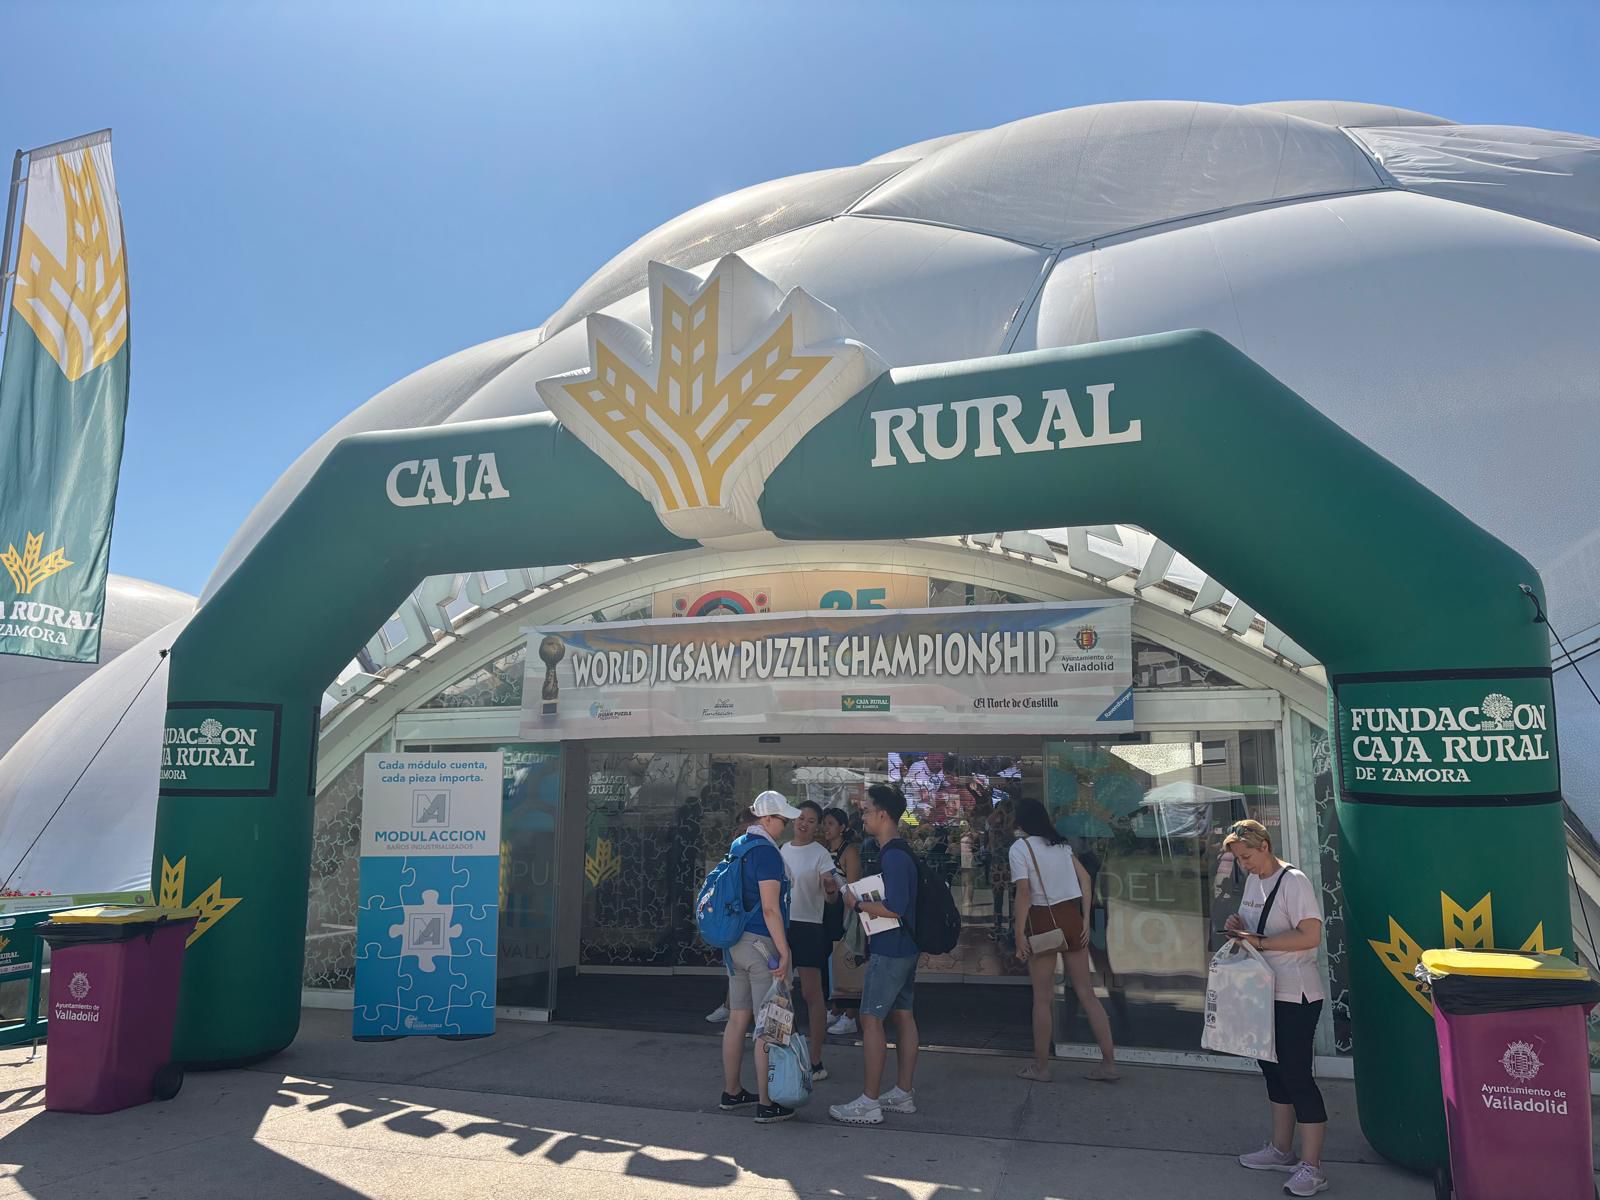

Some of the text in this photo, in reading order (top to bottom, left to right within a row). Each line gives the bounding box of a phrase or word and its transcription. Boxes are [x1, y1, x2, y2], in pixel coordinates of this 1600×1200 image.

[386, 383, 1142, 507] CAJA RURAL
[9, 601, 98, 630] RURAL
[0, 623, 68, 645] ZAMORA
[572, 630, 1057, 688] WORLD JIGSAW PUZZLE CHAMPIONSHIP
[1061, 661, 1114, 672] Valladolid
[973, 697, 1059, 709] El Norte de Castilla
[175, 747, 255, 767] RURAL
[1352, 736, 1432, 765] CAJA
[1441, 734, 1550, 764] RURAL
[378, 759, 488, 770] Cada módulo cuenta,
[381, 773, 484, 785] cada pieza importa.
[1356, 766, 1472, 783] DE ZAMORA
[374, 830, 486, 842] MODULACCION
[55, 1010, 100, 1022] Valladolid
[1481, 1083, 1567, 1098] Ayuntamiento de
[1481, 1094, 1568, 1115] Valladolid
